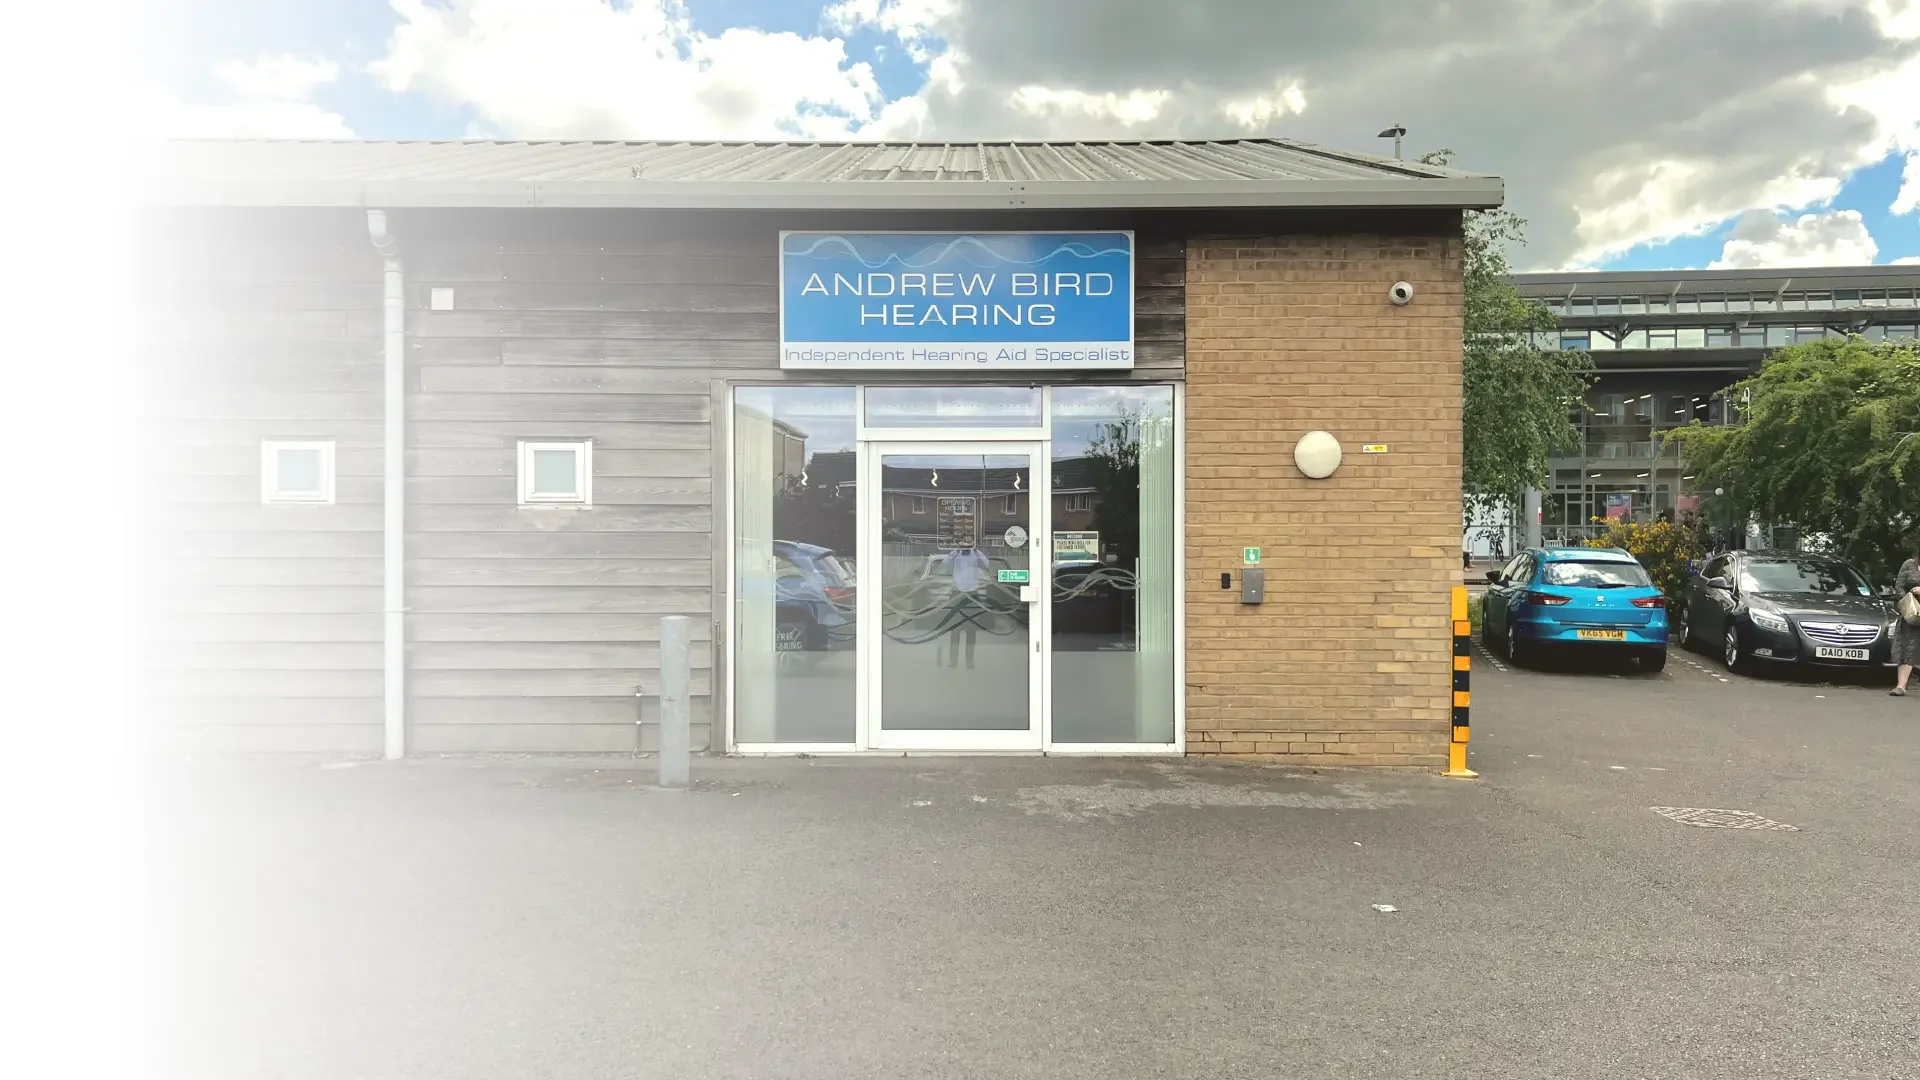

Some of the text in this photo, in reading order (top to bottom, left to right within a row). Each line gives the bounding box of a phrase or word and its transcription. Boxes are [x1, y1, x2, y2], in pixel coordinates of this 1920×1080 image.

[801, 272, 1113, 296] ANDREW BIRD
[860, 304, 1056, 326] HEARING
[784, 348, 1130, 363] Independent Hearing Aid Specialist
[1845, 649, 1864, 659] KOB
